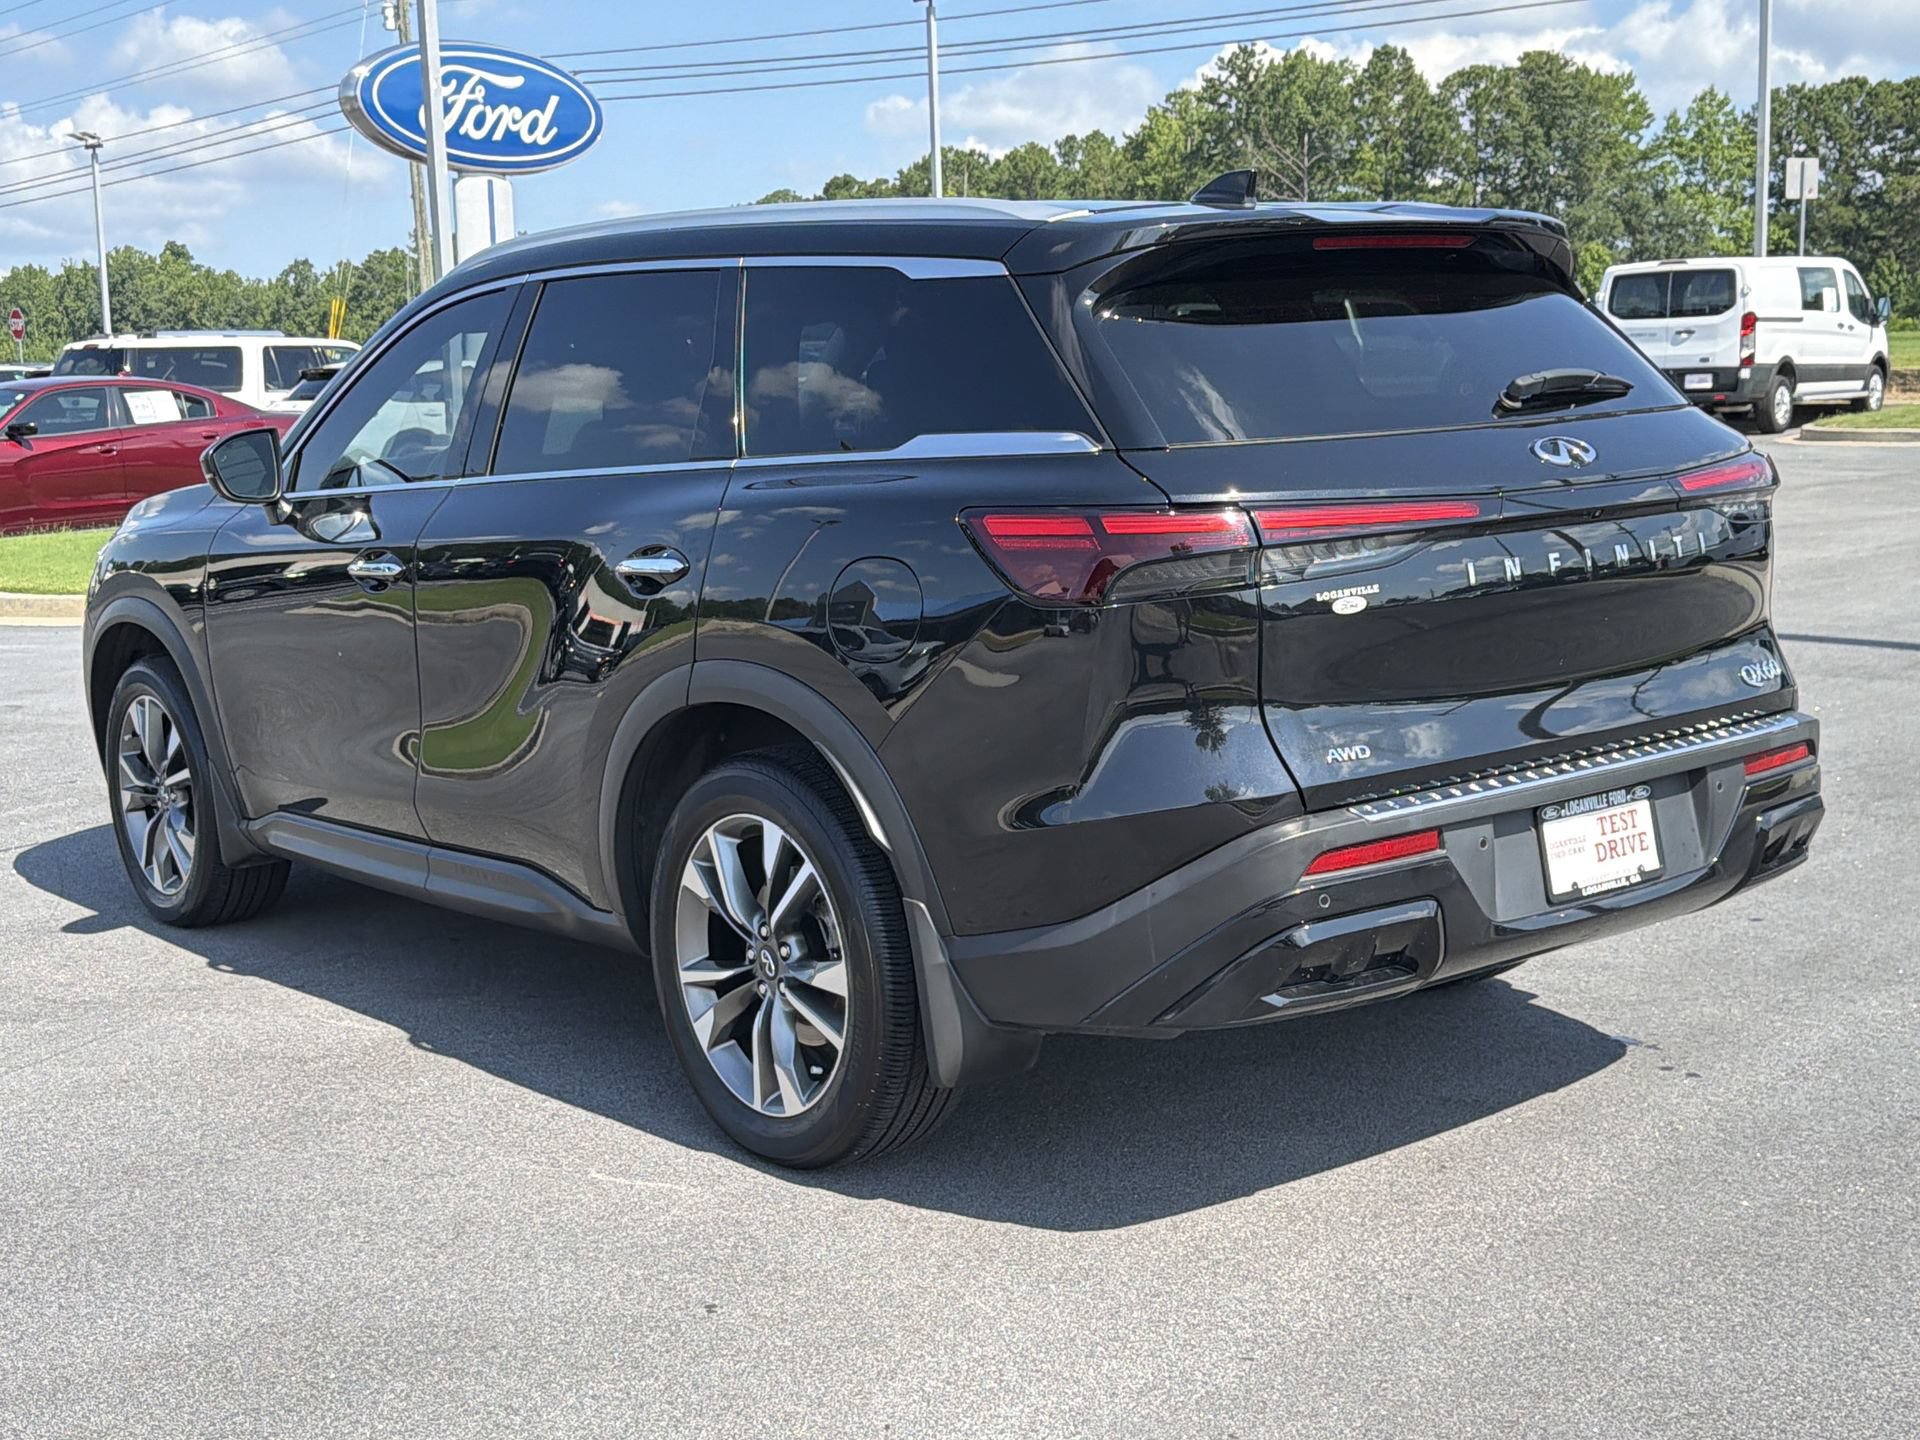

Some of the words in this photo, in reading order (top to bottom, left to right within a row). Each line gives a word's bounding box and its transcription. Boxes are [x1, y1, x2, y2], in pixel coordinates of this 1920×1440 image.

[418, 64, 560, 145] Ford
[1466, 532, 1706, 587] INFINITI
[1315, 583, 1380, 602] LOGANVILLE
[1740, 658, 1781, 687] QX60
[1326, 744, 1371, 764] AWD
[1564, 794, 1608, 816] LOGANVILLE
[1608, 789, 1627, 806] FORD
[1596, 809, 1638, 836] TEST
[1594, 831, 1650, 863] DRIVE
